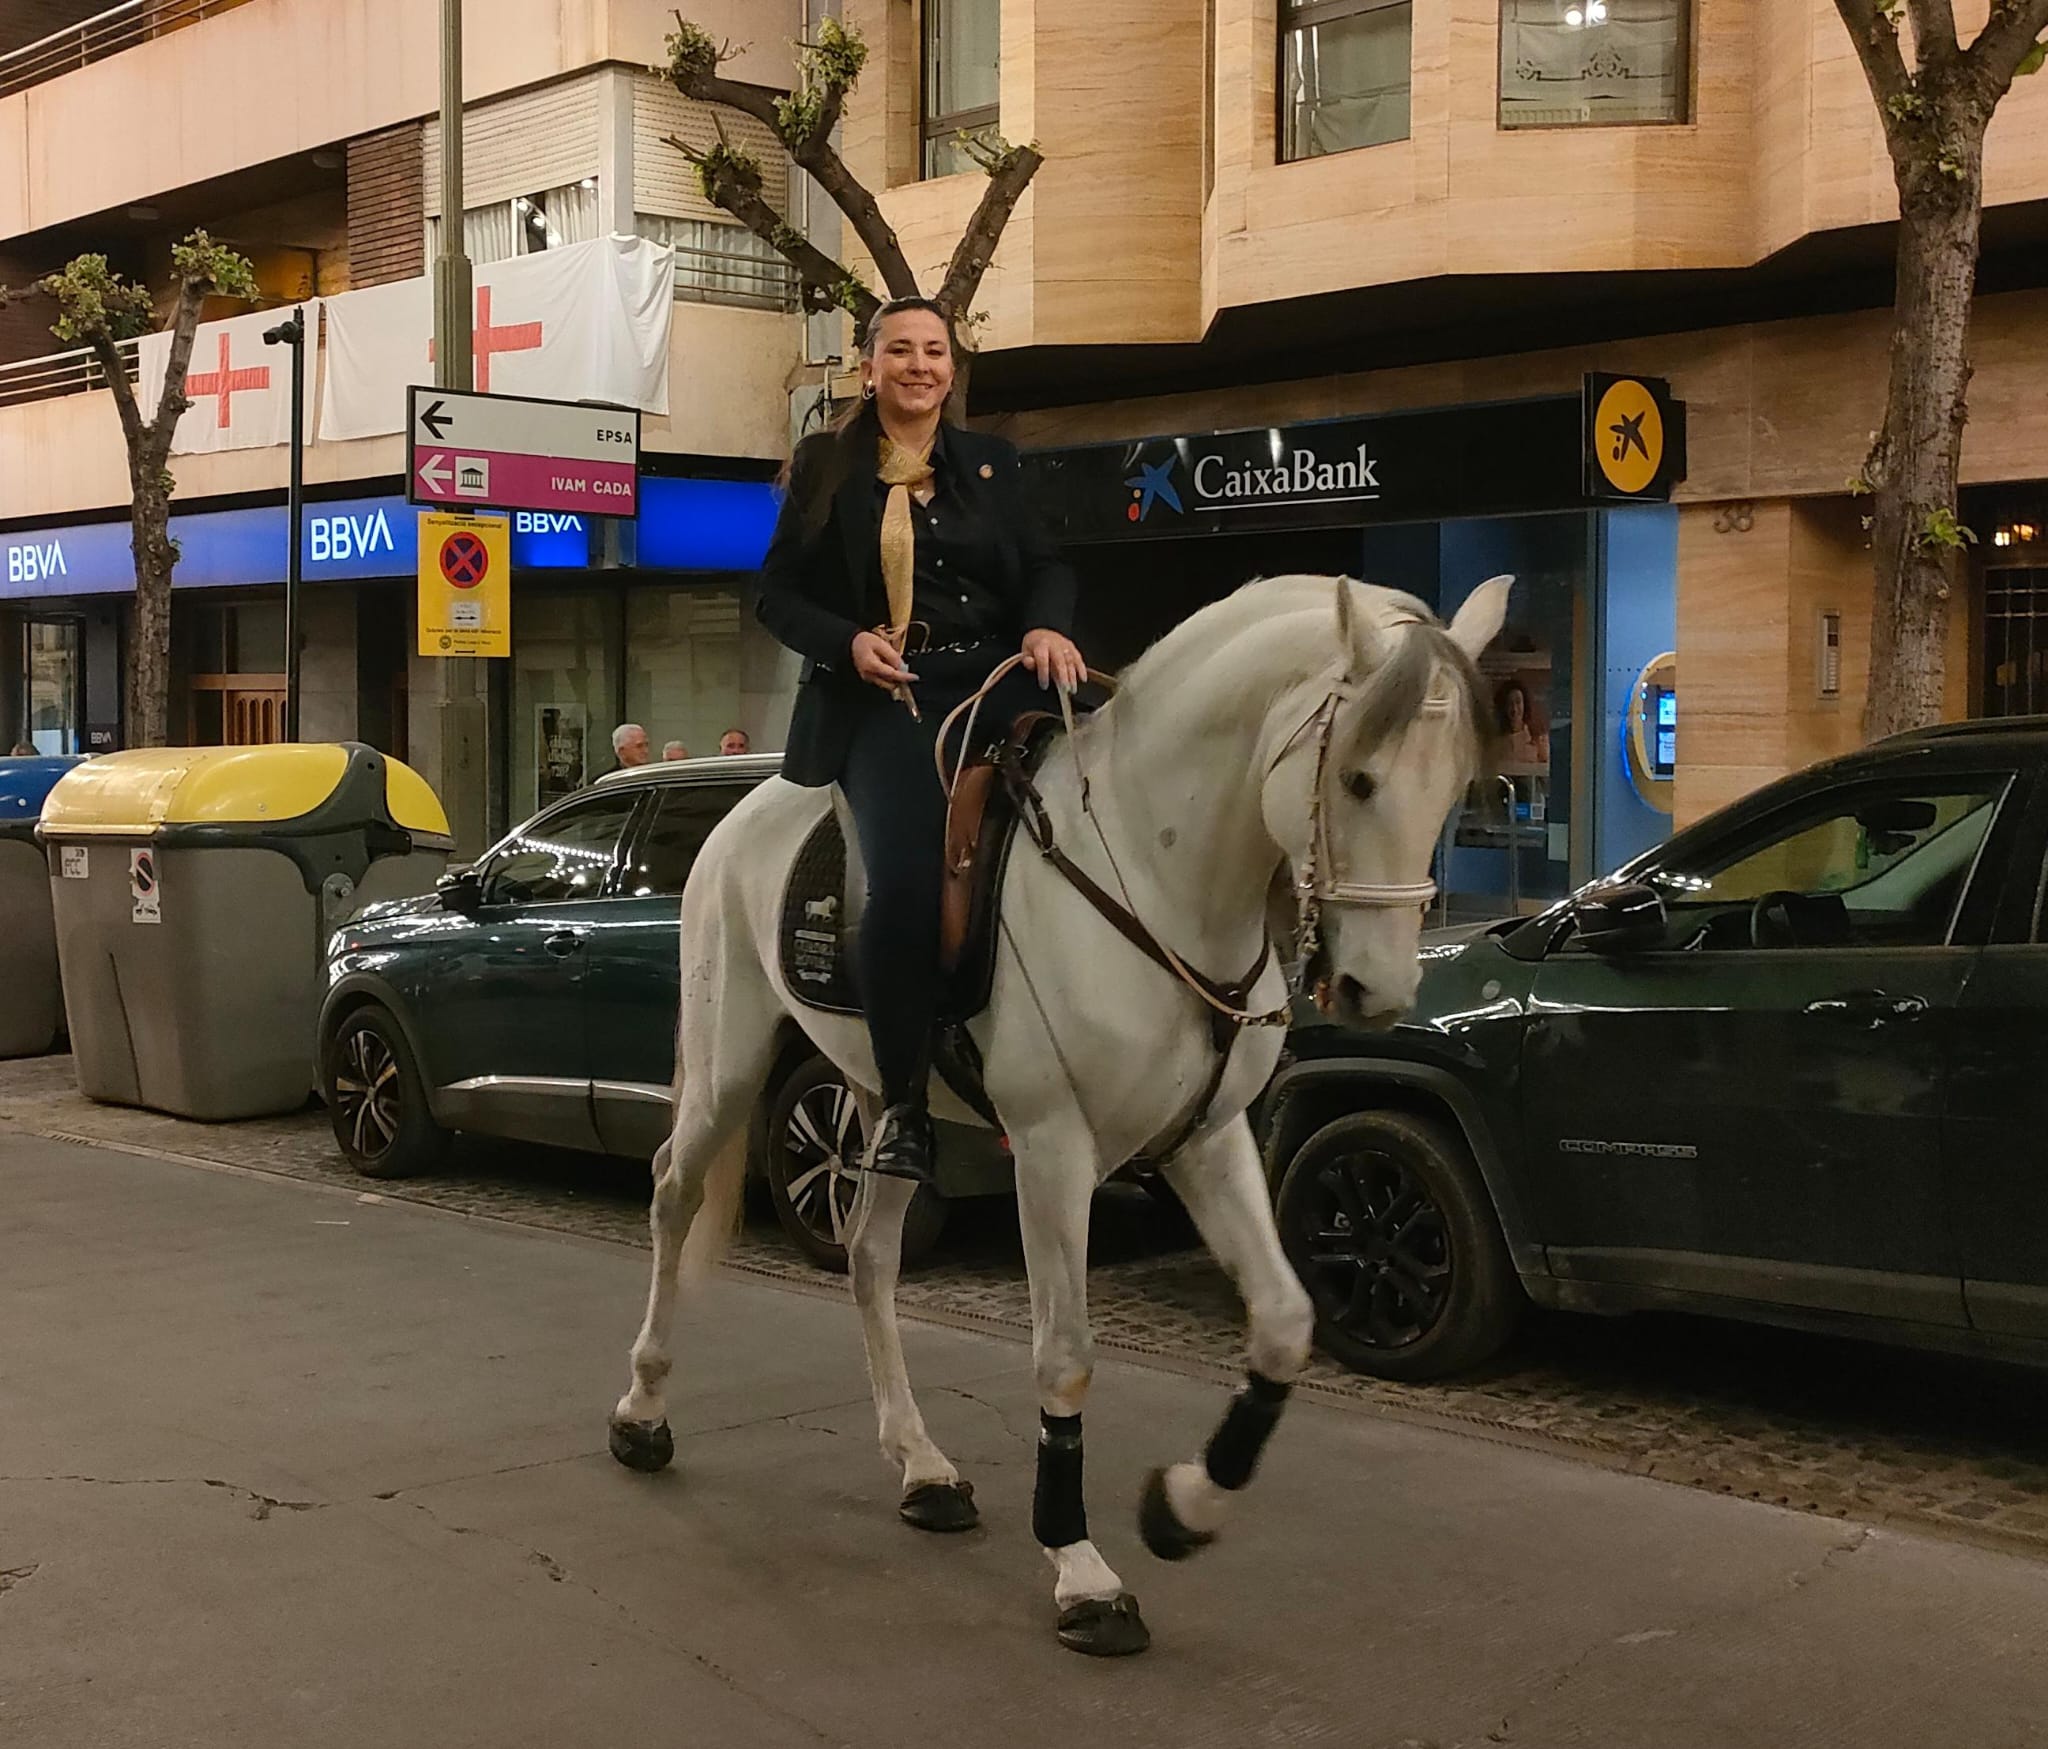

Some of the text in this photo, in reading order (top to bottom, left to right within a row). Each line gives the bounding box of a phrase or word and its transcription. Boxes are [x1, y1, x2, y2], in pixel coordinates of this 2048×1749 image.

[596, 429, 633, 445] EPSA
[1194, 443, 1380, 499] CaixaBank
[551, 477, 632, 497] IVAM CADA
[516, 511, 583, 534] BBVA
[1711, 504, 1755, 535] 38
[311, 507, 394, 561] BBVA
[8, 538, 67, 582] BBVA
[90, 730, 112, 744] BBVA
[1559, 1139, 1698, 1159] COMPASS
